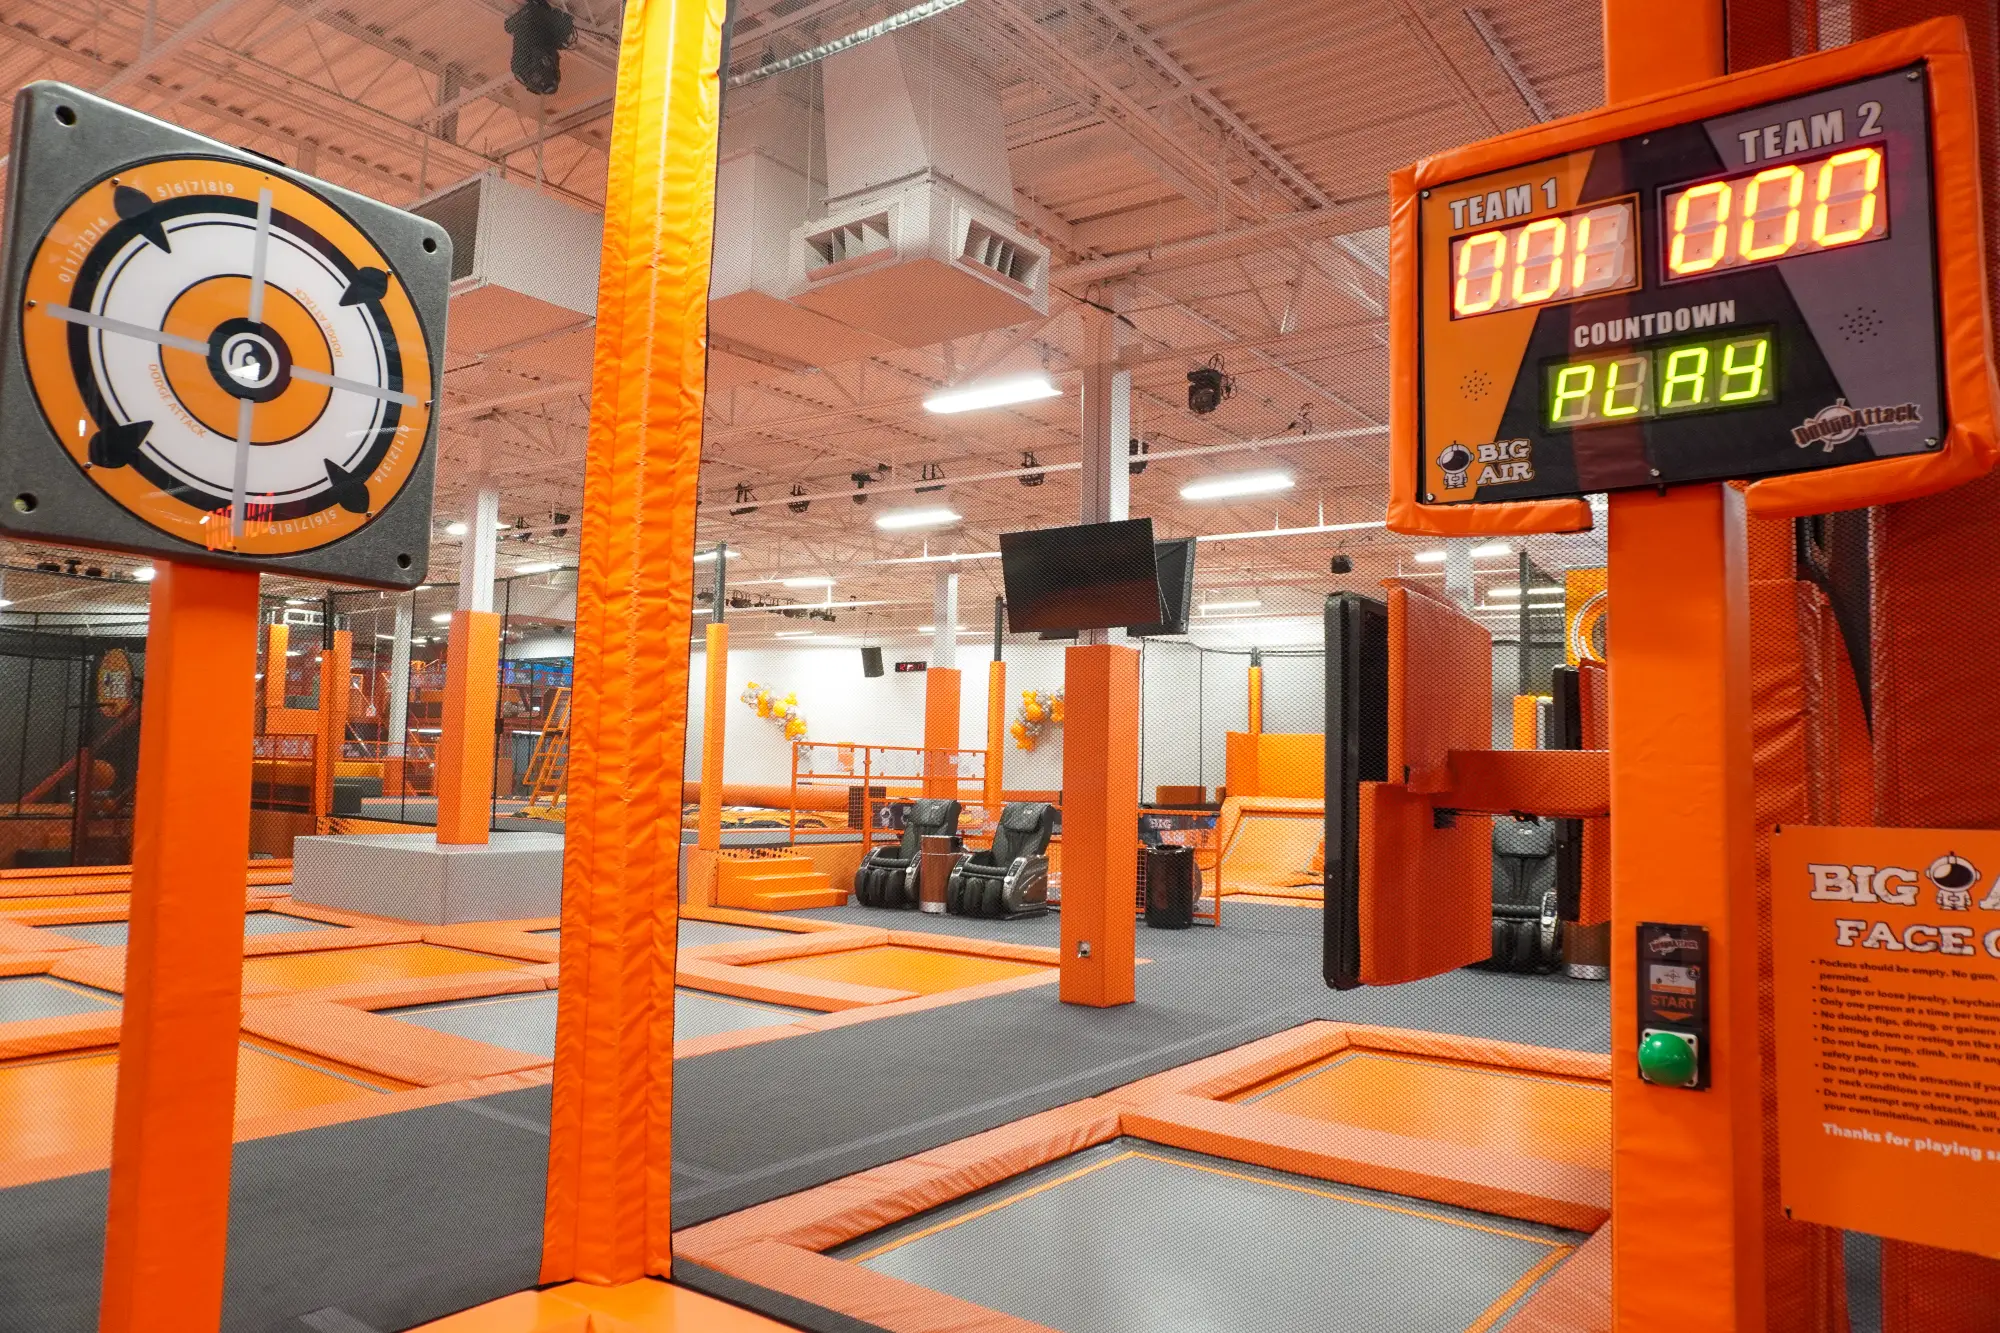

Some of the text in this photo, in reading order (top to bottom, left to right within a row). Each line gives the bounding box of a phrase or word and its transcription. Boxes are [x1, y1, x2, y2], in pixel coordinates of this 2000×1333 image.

[1738, 101, 1883, 164] TEAM 2
[1449, 177, 1557, 230] TEAM 1
[1669, 147, 1881, 274] 000
[1454, 215, 1589, 315] 001
[1574, 300, 1736, 348] COUNTDOWN
[147, 363, 207, 438] DODGE ATTACK
[1552, 339, 1767, 423] PLAY
[1793, 403, 1922, 447] DodgeAttack
[1476, 461, 1535, 486] AIR
[1477, 438, 1532, 463] BIG
[1807, 863, 1920, 906] BIG
[1834, 919, 1976, 956] FACE
[1650, 995, 1696, 1009] START
[1822, 1123, 1881, 1142] Thanks
[1885, 1132, 1911, 1147] for
[1914, 1138, 1982, 1161] playing
